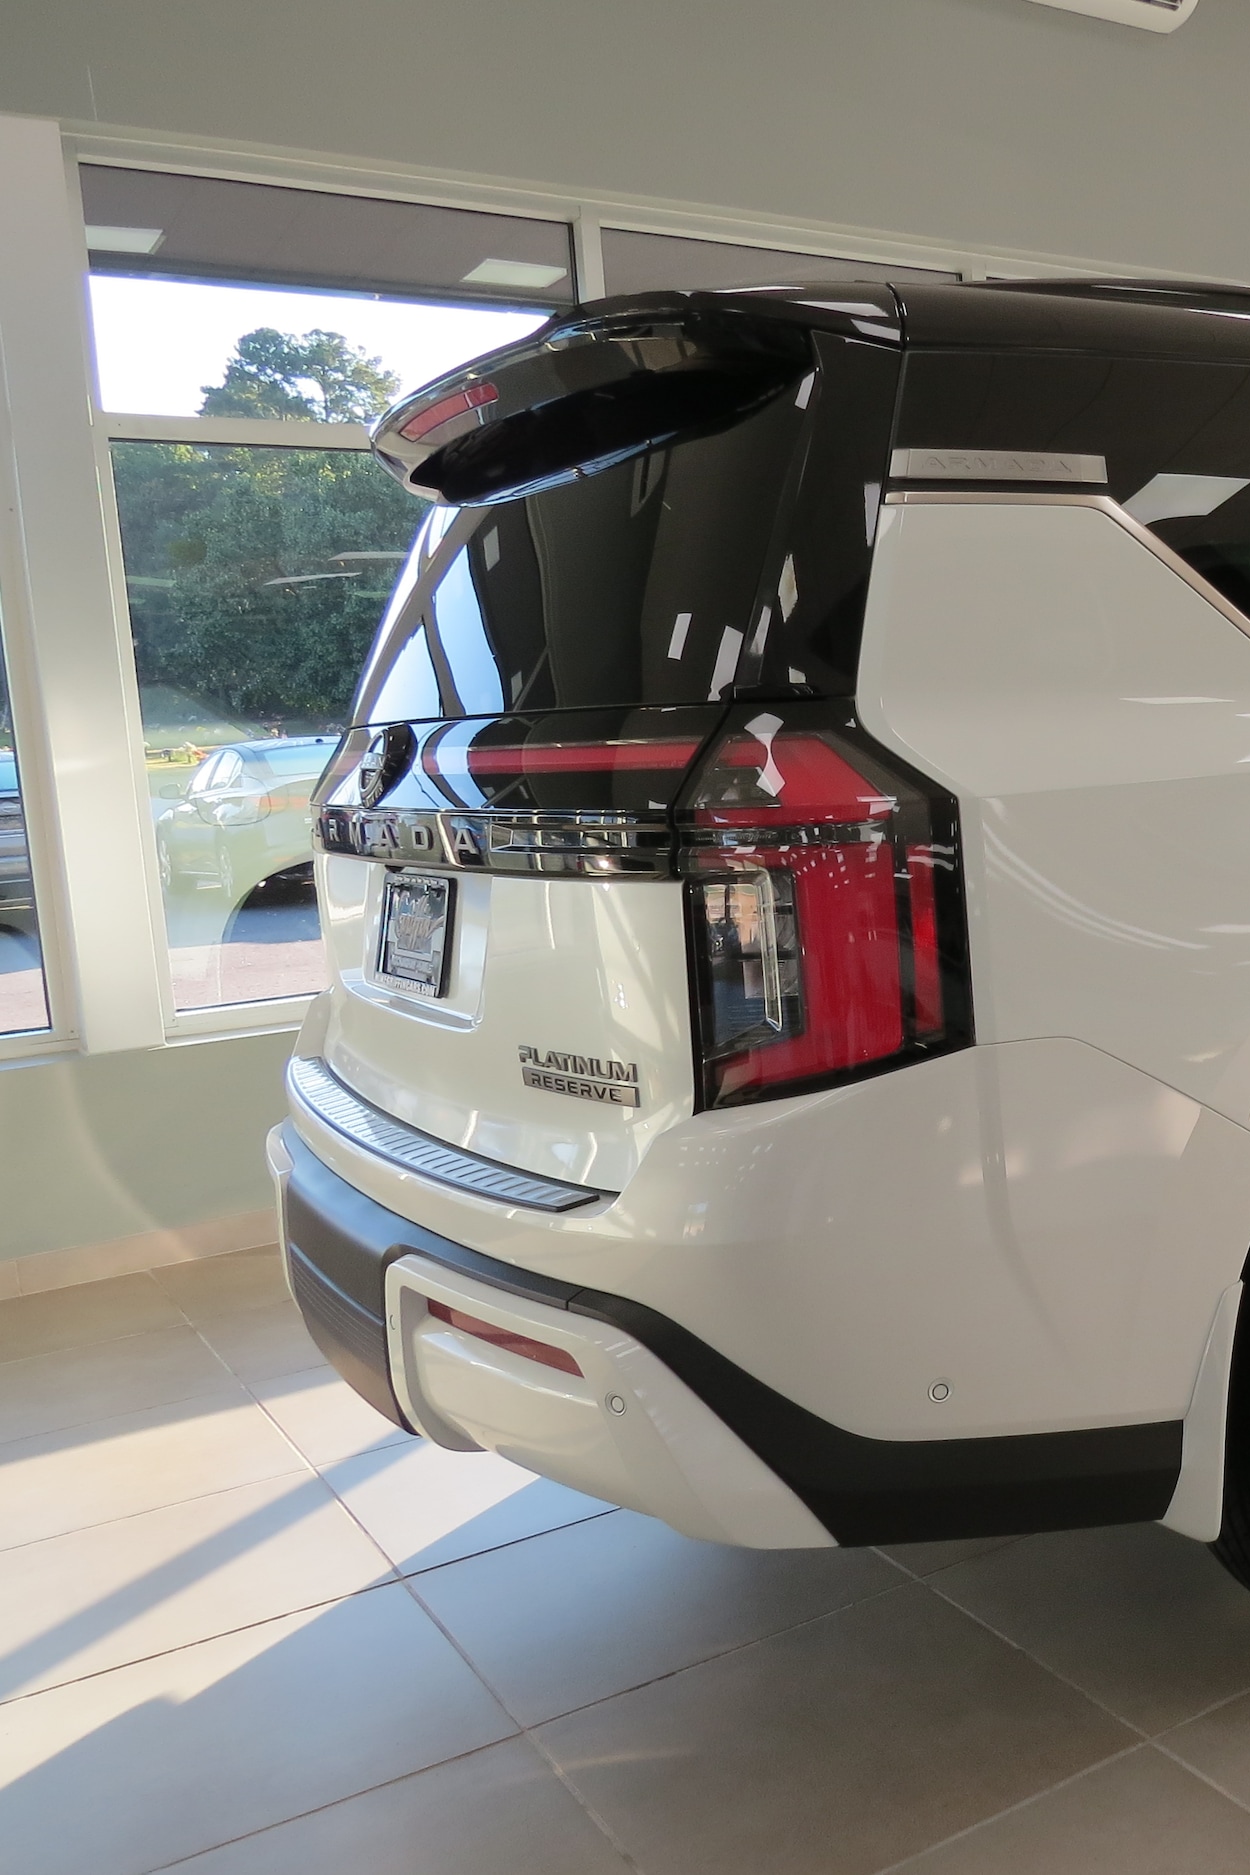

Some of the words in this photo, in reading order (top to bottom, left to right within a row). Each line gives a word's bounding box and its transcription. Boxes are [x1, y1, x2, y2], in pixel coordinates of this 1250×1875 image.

[312, 817, 477, 855] ARMADA
[518, 1044, 638, 1082] PLATINUM
[531, 1073, 622, 1102] RESERVE
